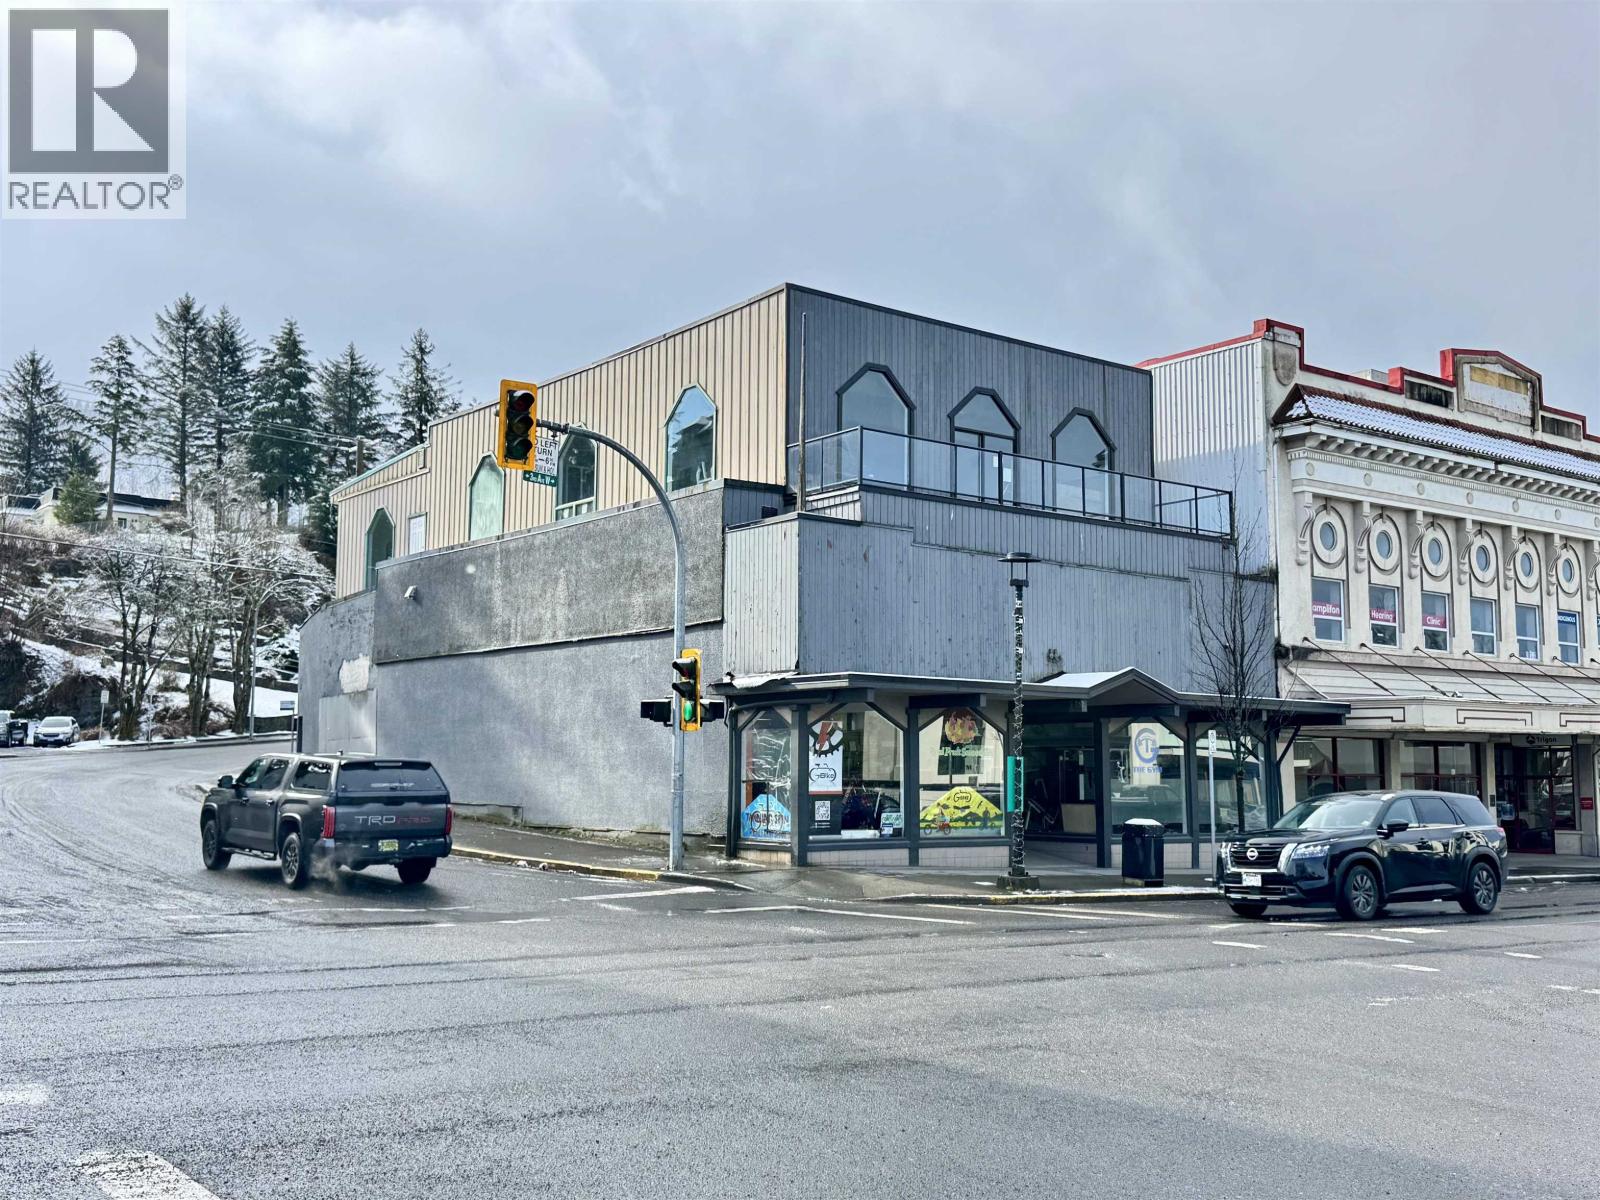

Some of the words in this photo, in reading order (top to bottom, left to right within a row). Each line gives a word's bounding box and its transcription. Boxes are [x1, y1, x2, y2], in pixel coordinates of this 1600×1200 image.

[541, 440, 557, 449] LEFT
[536, 447, 553, 456] URN
[1312, 603, 1340, 615] amplifon
[1371, 610, 1393, 623] Hearing
[1426, 616, 1441, 626] Clinic
